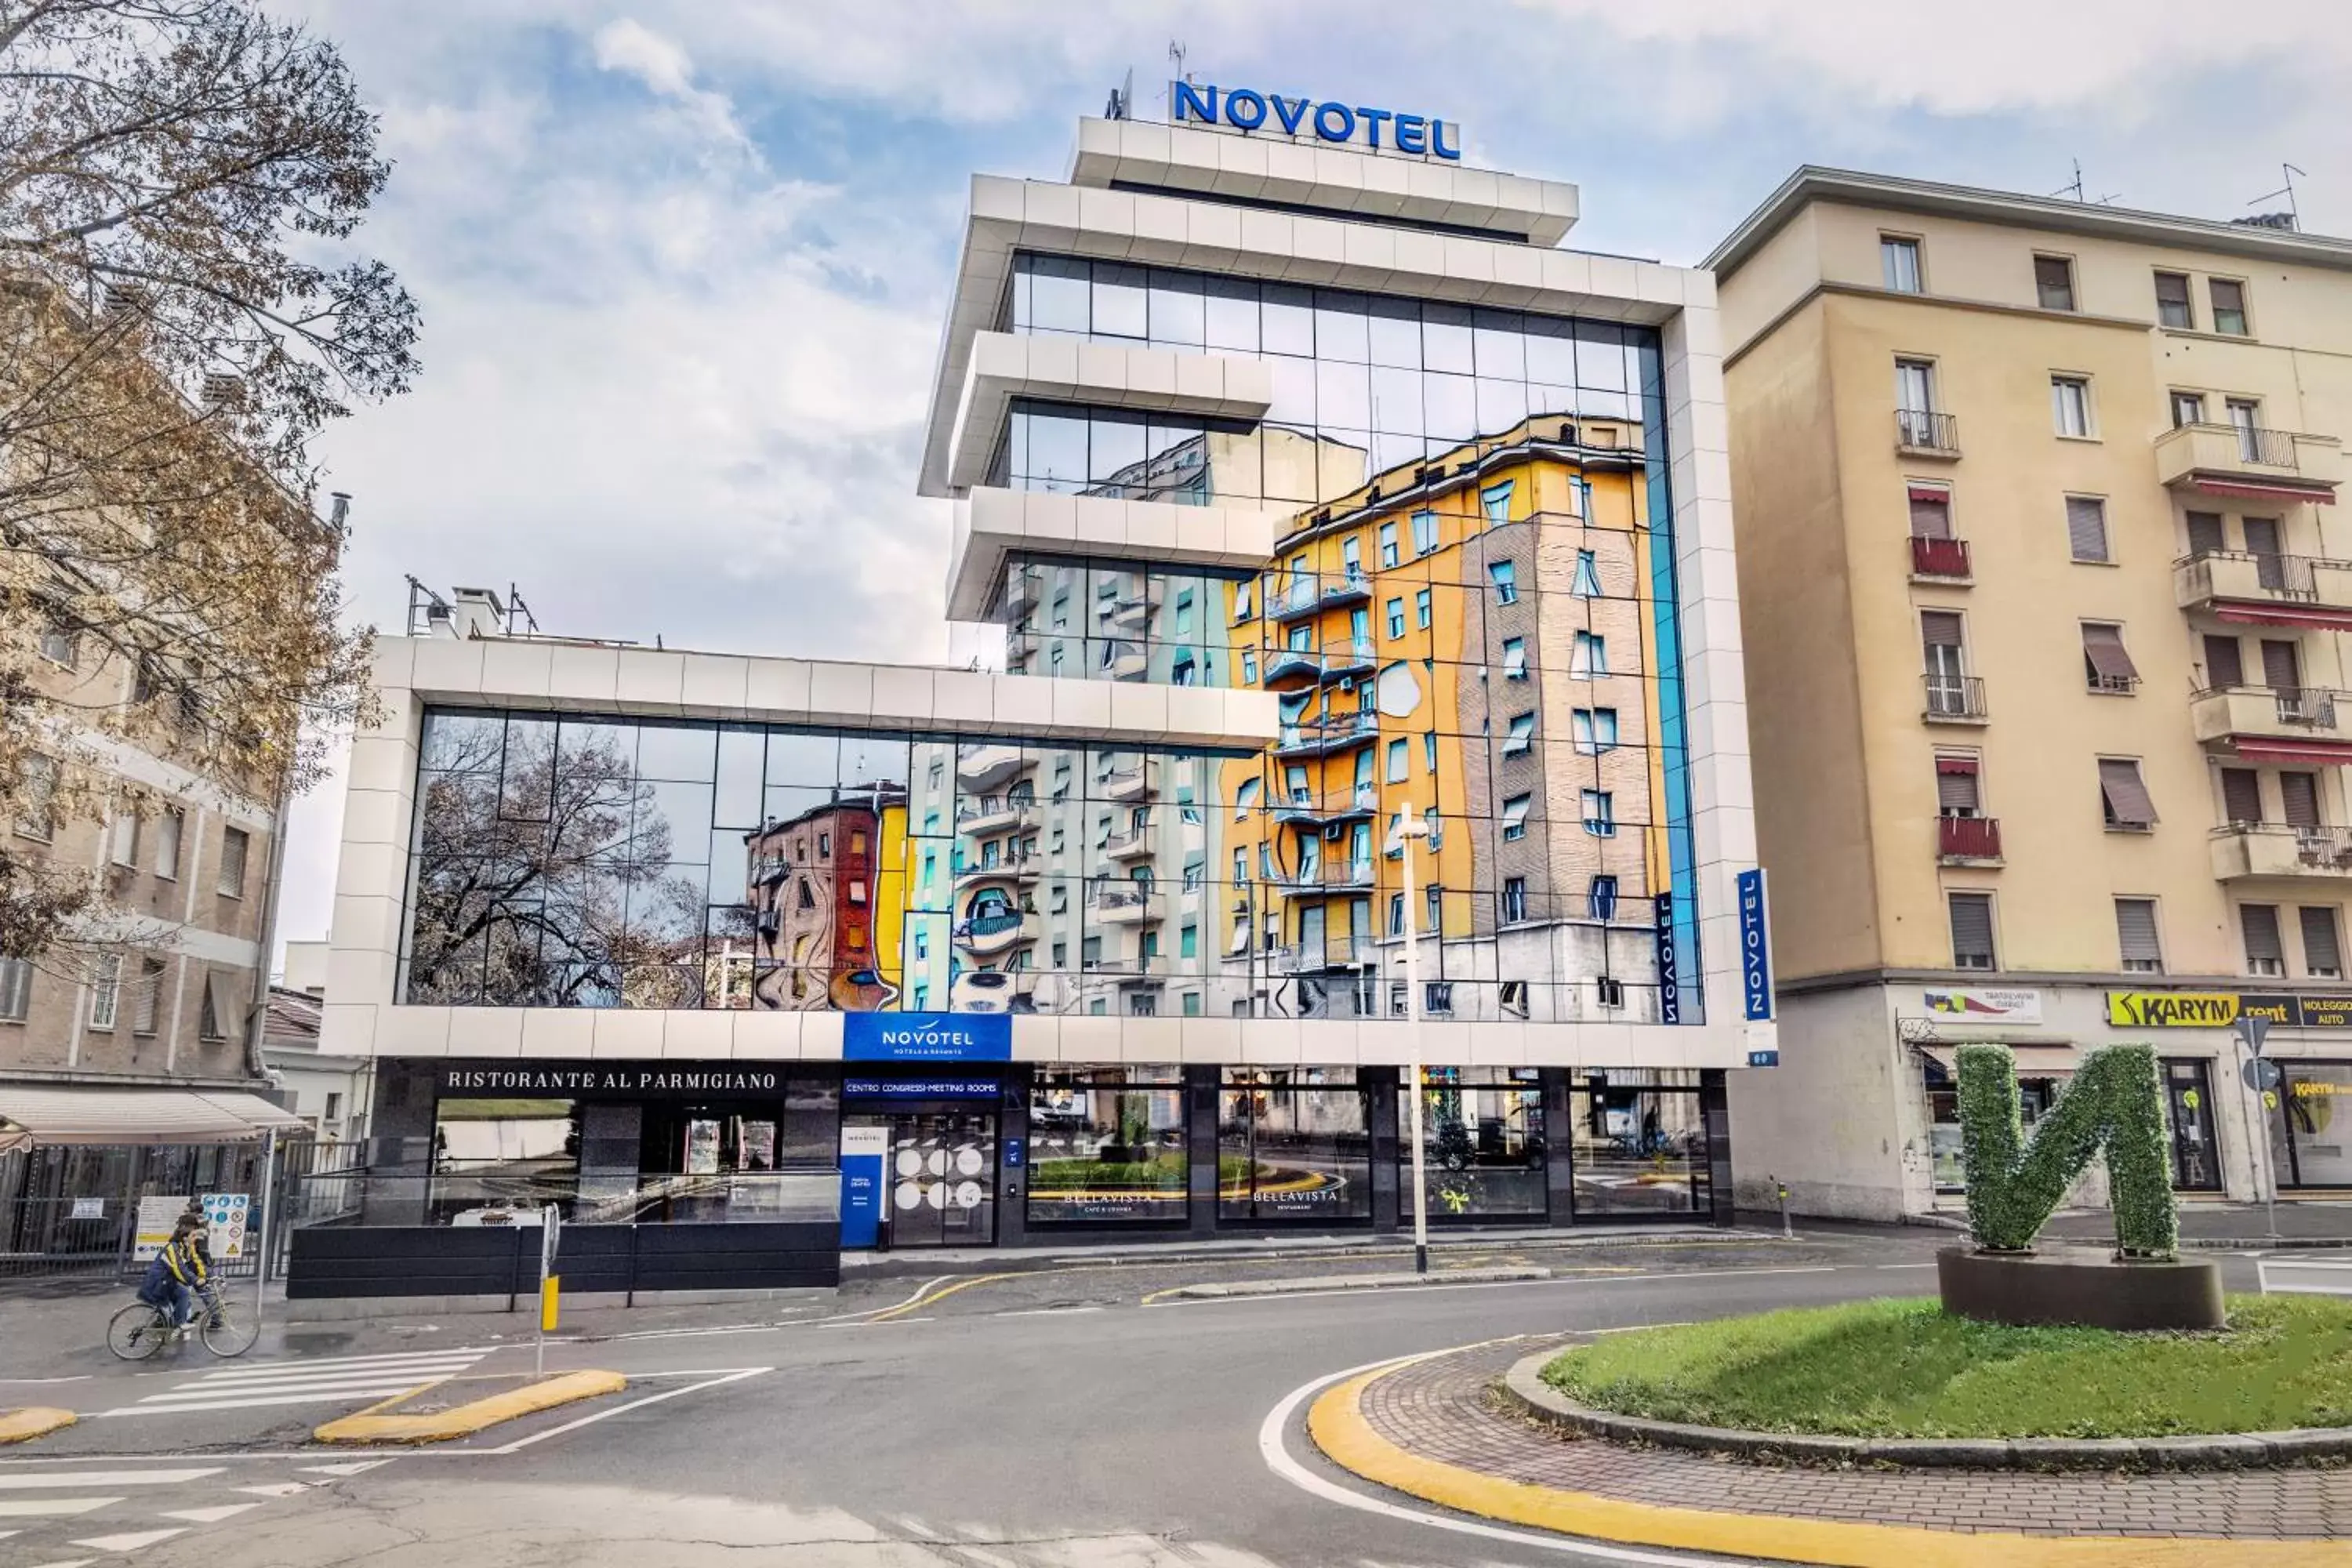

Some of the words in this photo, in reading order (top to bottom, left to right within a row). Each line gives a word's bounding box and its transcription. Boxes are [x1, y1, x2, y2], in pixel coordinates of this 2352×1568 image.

[1175, 80, 1461, 160] NOVOTEL
[1744, 877, 1764, 1012] NOVOTEL
[2142, 998, 2230, 1025] KARYM
[2303, 1000, 2352, 1011] NOLEGGIO
[2318, 1014, 2345, 1025] AUTO
[882, 1031, 975, 1045] NOVOTEL
[448, 1071, 596, 1088] RISTORANTE
[603, 1073, 632, 1089] AL
[640, 1073, 776, 1090] PARMIGIANO
[846, 1083, 880, 1093] CENTRO
[967, 1083, 996, 1093] ROOMS
[2294, 1083, 2335, 1097] KARYM
[1065, 1193, 1152, 1203] BELLAVISTA
[1254, 1191, 1338, 1202] BELLAVISTA
